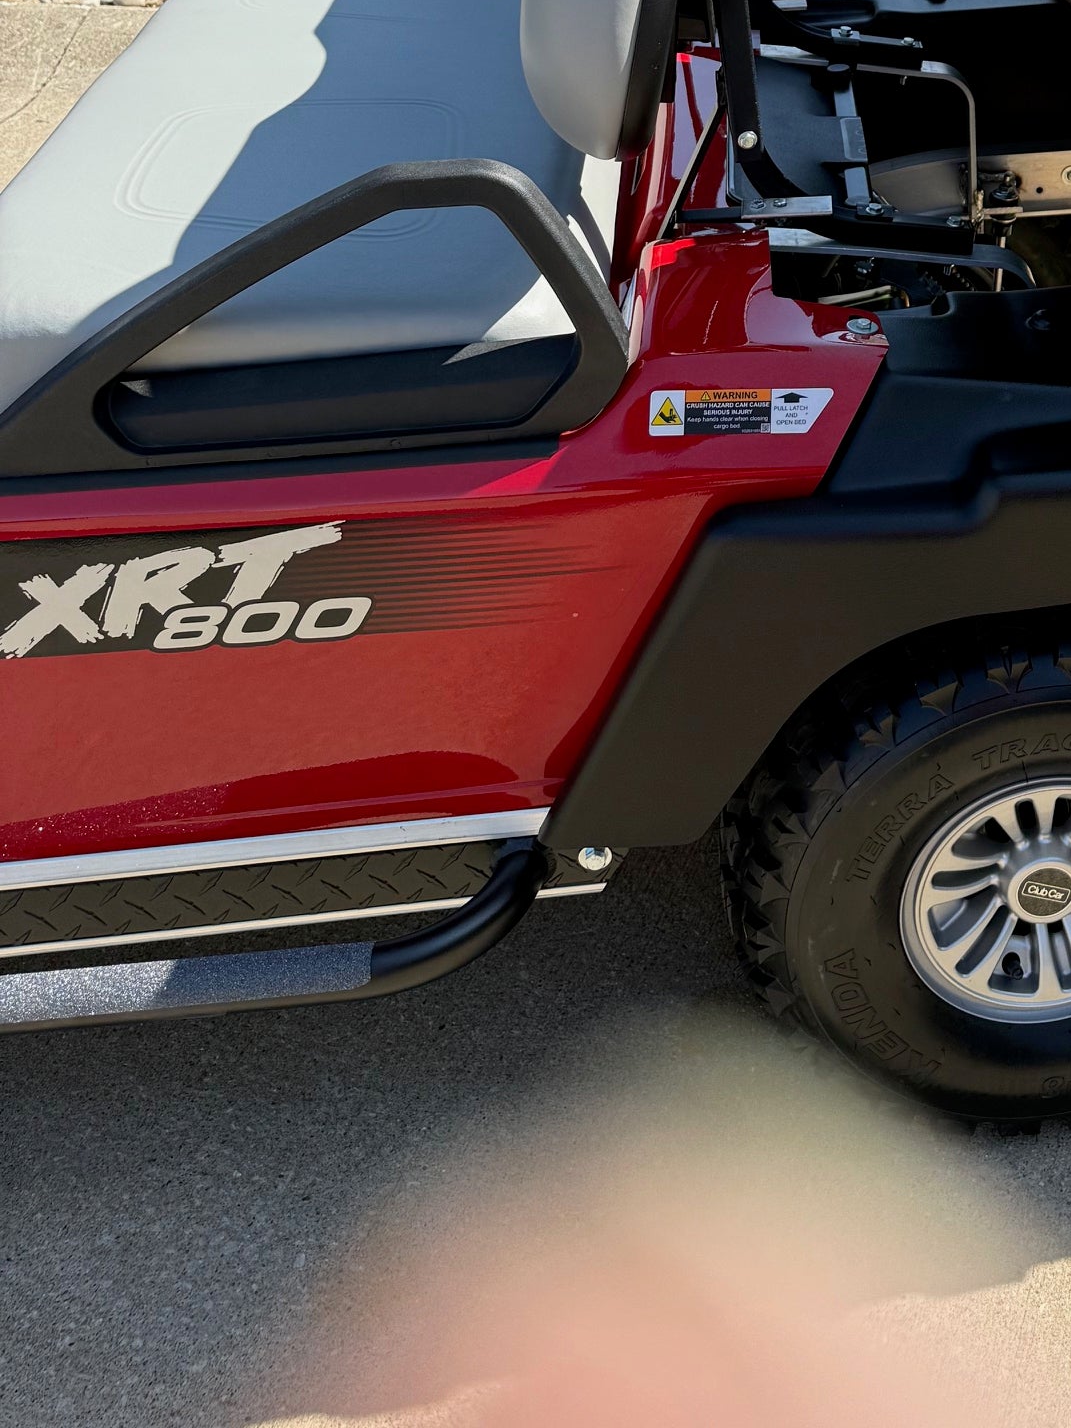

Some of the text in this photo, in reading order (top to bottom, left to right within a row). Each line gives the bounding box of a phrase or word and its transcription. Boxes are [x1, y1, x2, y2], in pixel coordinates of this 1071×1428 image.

[713, 392, 758, 400] WARNING
[0, 520, 346, 659] XRT
[152, 597, 373, 650] 800
[847, 773, 955, 882] TERRA
[1027, 884, 1065, 900] Club Car
[823, 947, 943, 1084] KENDA
